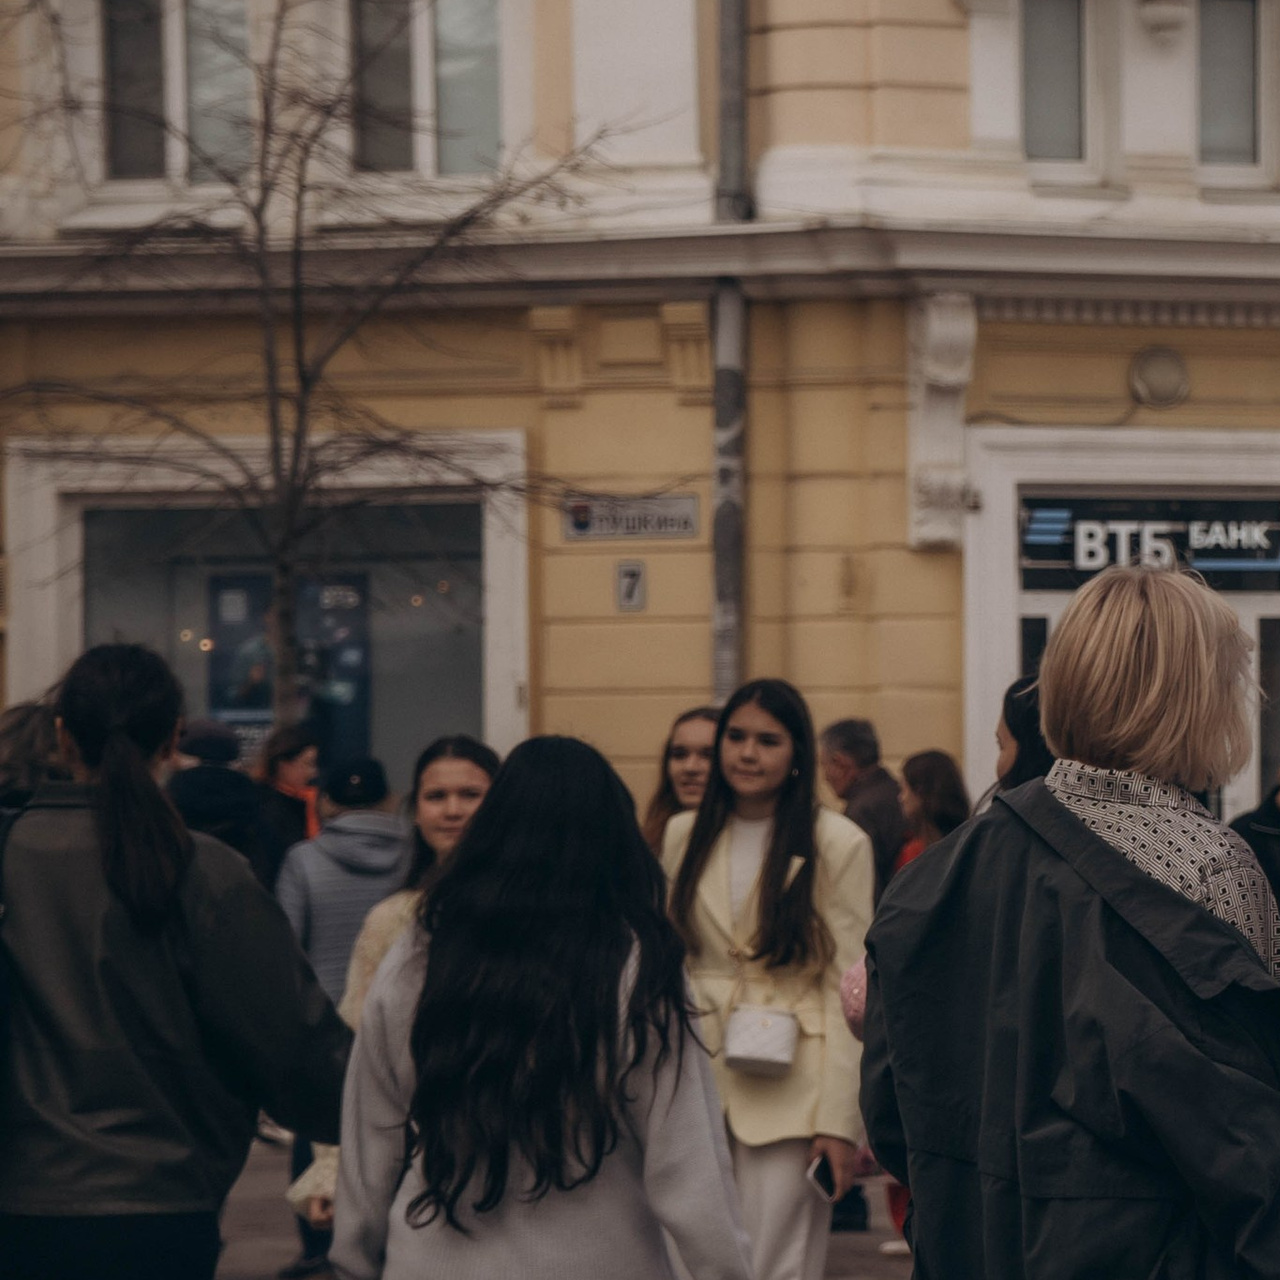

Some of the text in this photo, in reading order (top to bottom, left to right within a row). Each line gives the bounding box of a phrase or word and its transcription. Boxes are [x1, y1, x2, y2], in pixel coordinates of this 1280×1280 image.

[1074, 520, 1271, 570] ВТБ БАНК
[623, 569, 641, 601] 7
